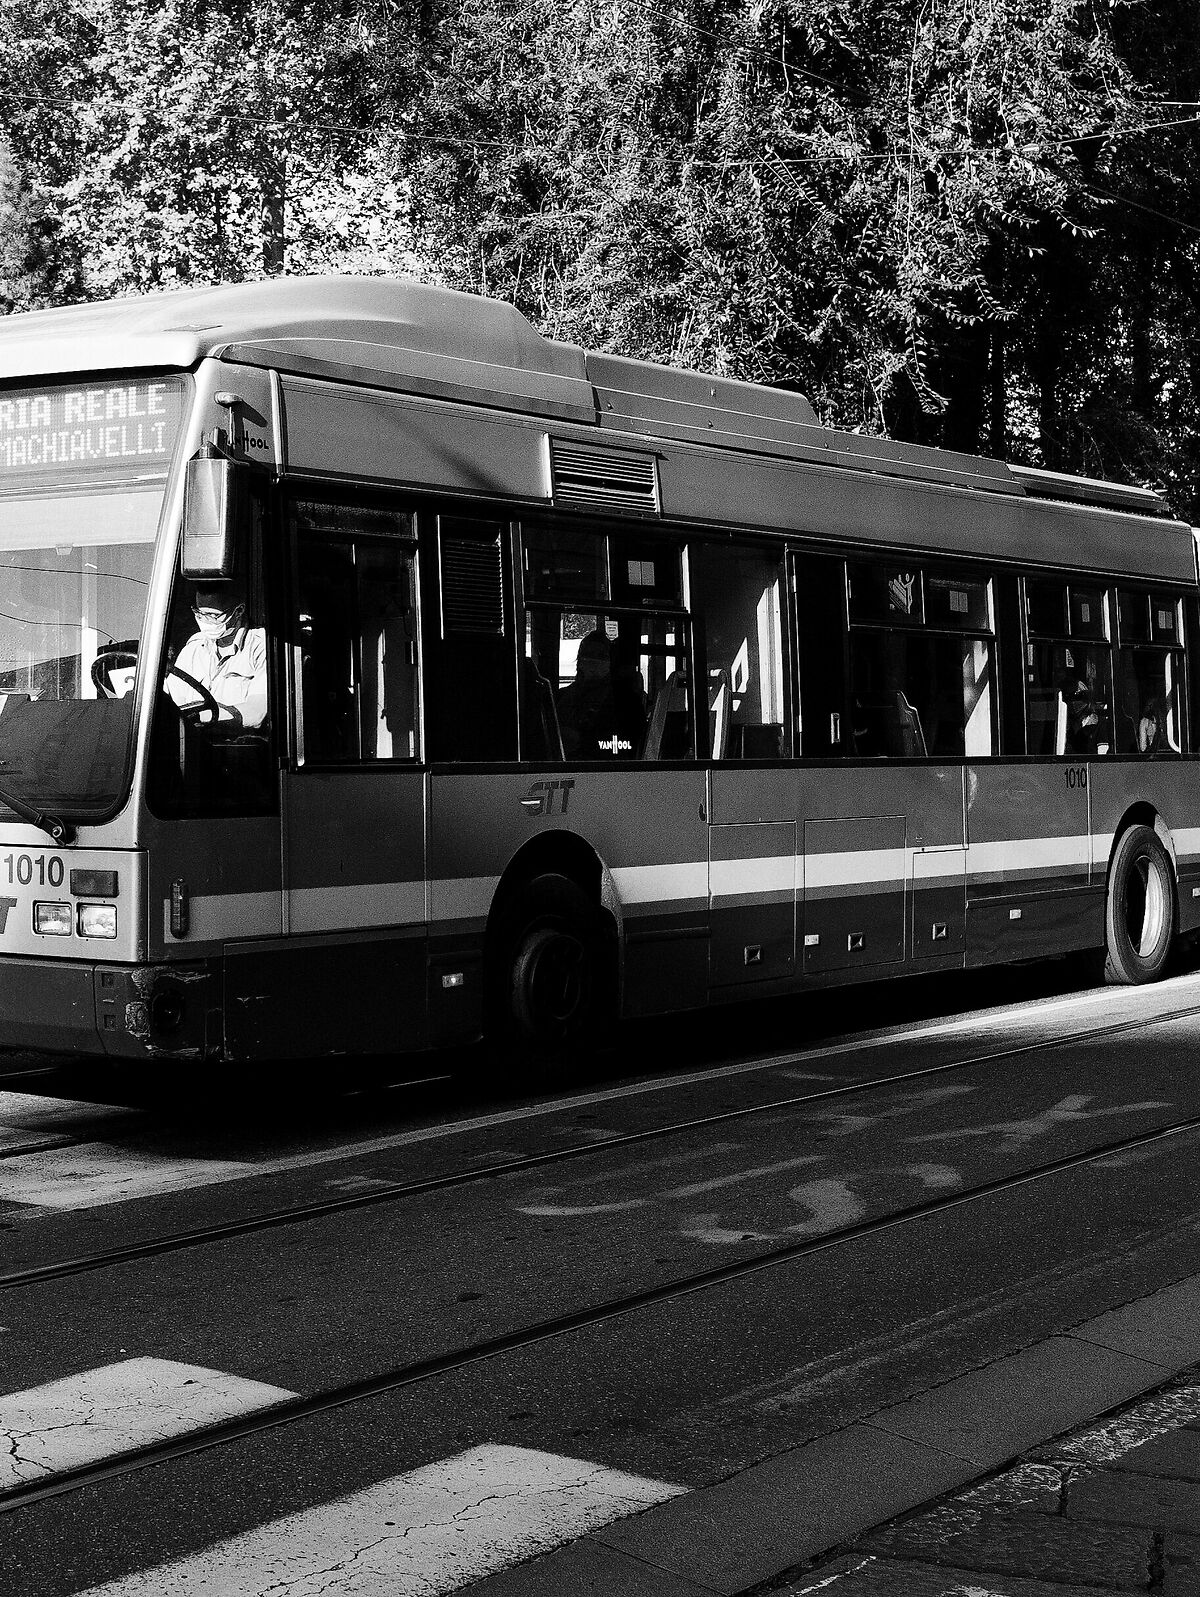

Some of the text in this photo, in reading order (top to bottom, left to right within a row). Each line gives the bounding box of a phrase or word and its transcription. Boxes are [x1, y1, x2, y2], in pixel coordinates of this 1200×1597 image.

[64, 383, 167, 423] REALE
[1064, 767, 1087, 789] 1010
[3, 853, 66, 887] 1010
